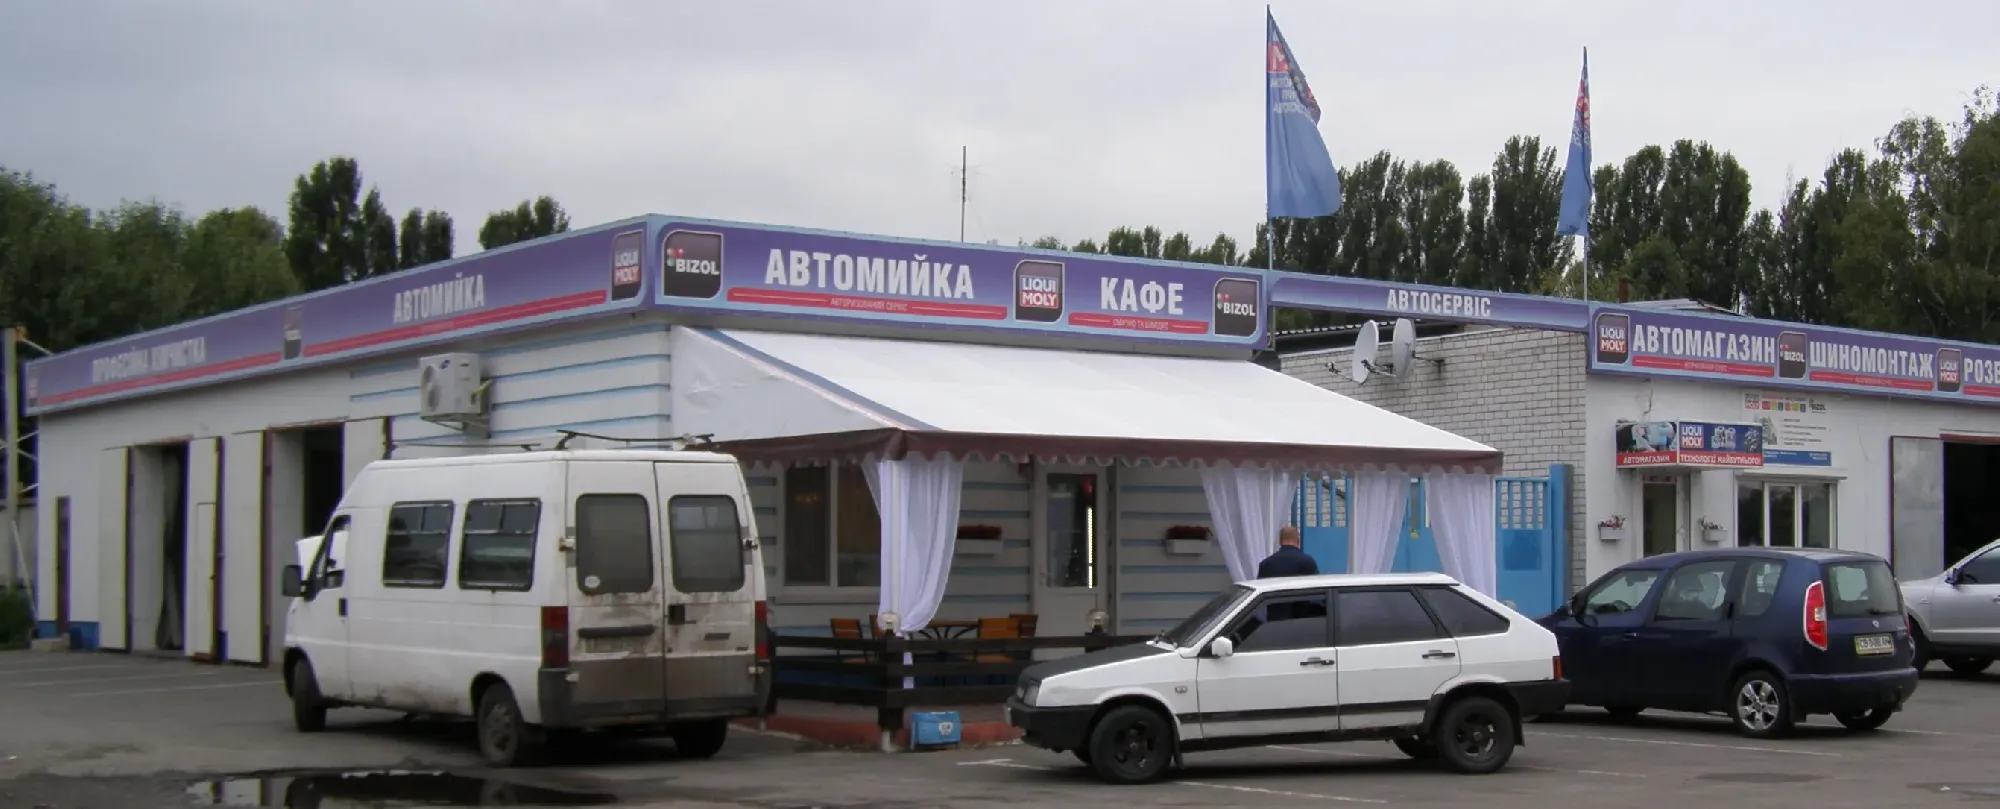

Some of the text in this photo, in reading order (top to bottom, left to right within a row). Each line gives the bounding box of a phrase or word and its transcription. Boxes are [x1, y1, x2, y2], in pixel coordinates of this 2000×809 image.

[615, 250, 639, 266] LIQUI
[614, 266, 639, 284] MOLY
[675, 259, 720, 276] BIZOL
[765, 249, 974, 299] АВТОМИЙКА
[1022, 276, 1057, 292] LIQUI
[394, 272, 485, 323] АВТОМИЙКА
[1022, 291, 1058, 307] MOLY
[1101, 277, 1184, 315] КАФЕ
[1387, 289, 1491, 318] АВТОСЕРВІС
[1223, 302, 1256, 317] BIZOL
[1601, 327, 1625, 340] LIQUI
[1601, 339, 1626, 351] MOLY
[1632, 324, 1775, 364] АВТОМАГАЗИН
[1784, 350, 1805, 362] BIZOL
[1809, 341, 1934, 379] ШИНОМОНТАЖ
[1681, 426, 1702, 436] LIQUI
[1681, 436, 1703, 448] MOLY
